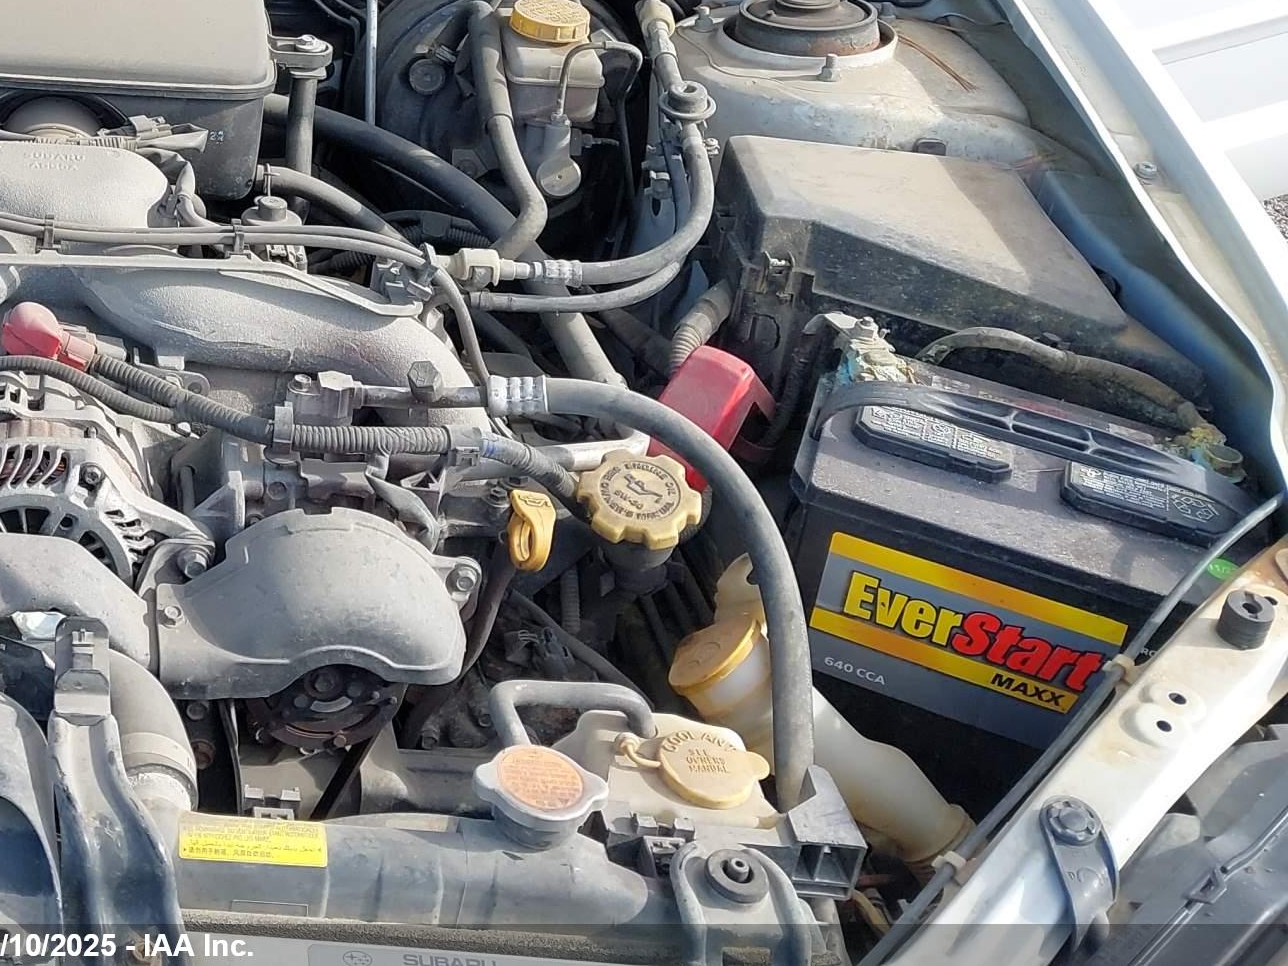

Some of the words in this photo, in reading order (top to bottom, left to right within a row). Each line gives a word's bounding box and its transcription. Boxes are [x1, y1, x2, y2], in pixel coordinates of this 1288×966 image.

[843, 570, 1105, 693] EverStart
[824, 657, 854, 673] 640
[856, 668, 885, 685] CCA
[990, 673, 1065, 706] MAXX
